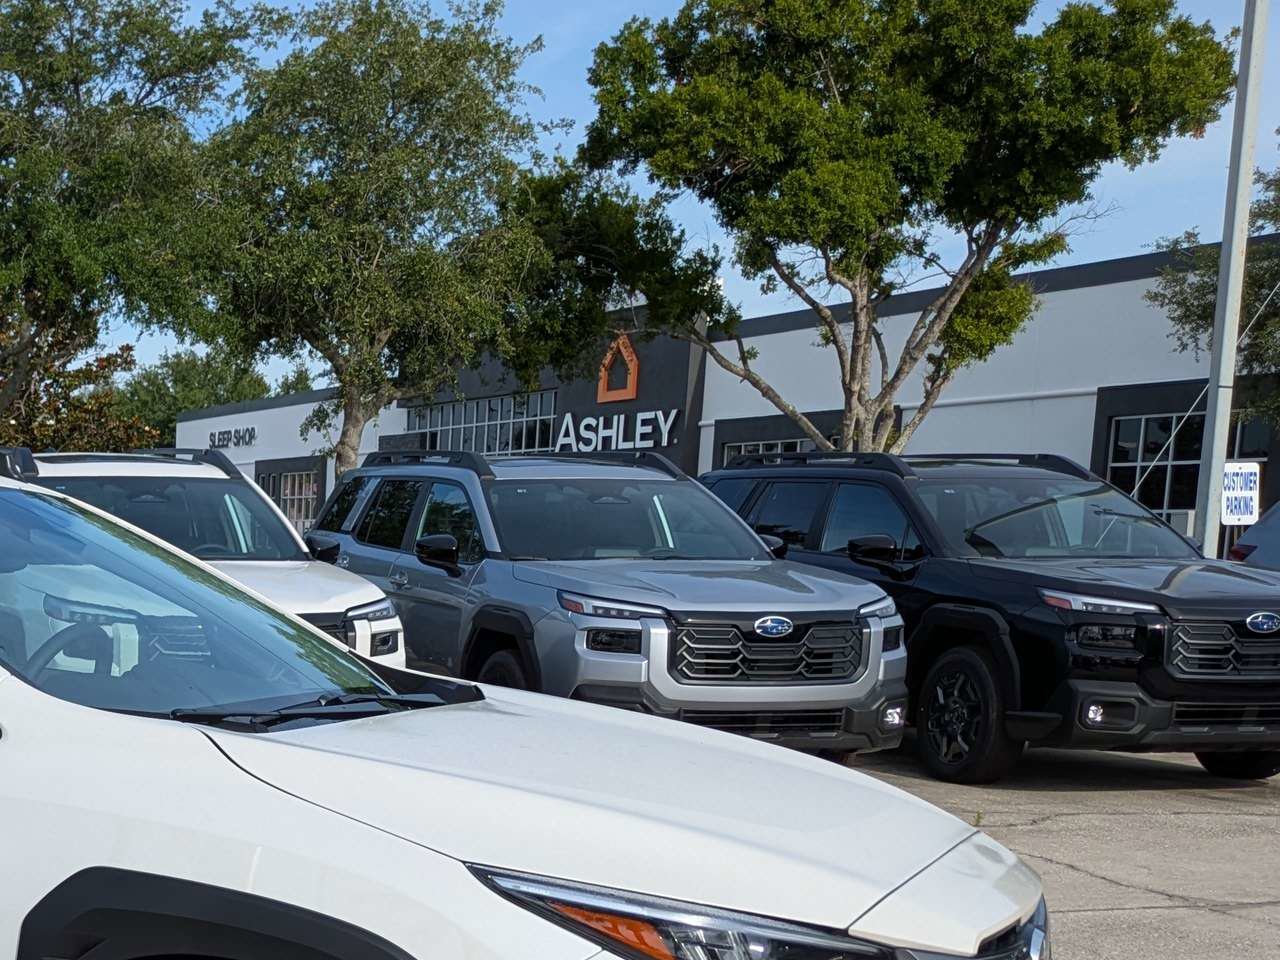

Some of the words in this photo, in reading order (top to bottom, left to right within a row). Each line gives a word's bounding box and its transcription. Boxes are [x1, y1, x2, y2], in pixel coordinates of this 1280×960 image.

[209, 429, 232, 449] SLEEP
[233, 426, 256, 447] SHOP
[554, 408, 678, 453] ASHLEY
[1222, 471, 1258, 491] CUSTOMER
[1226, 495, 1254, 516] PARKING
